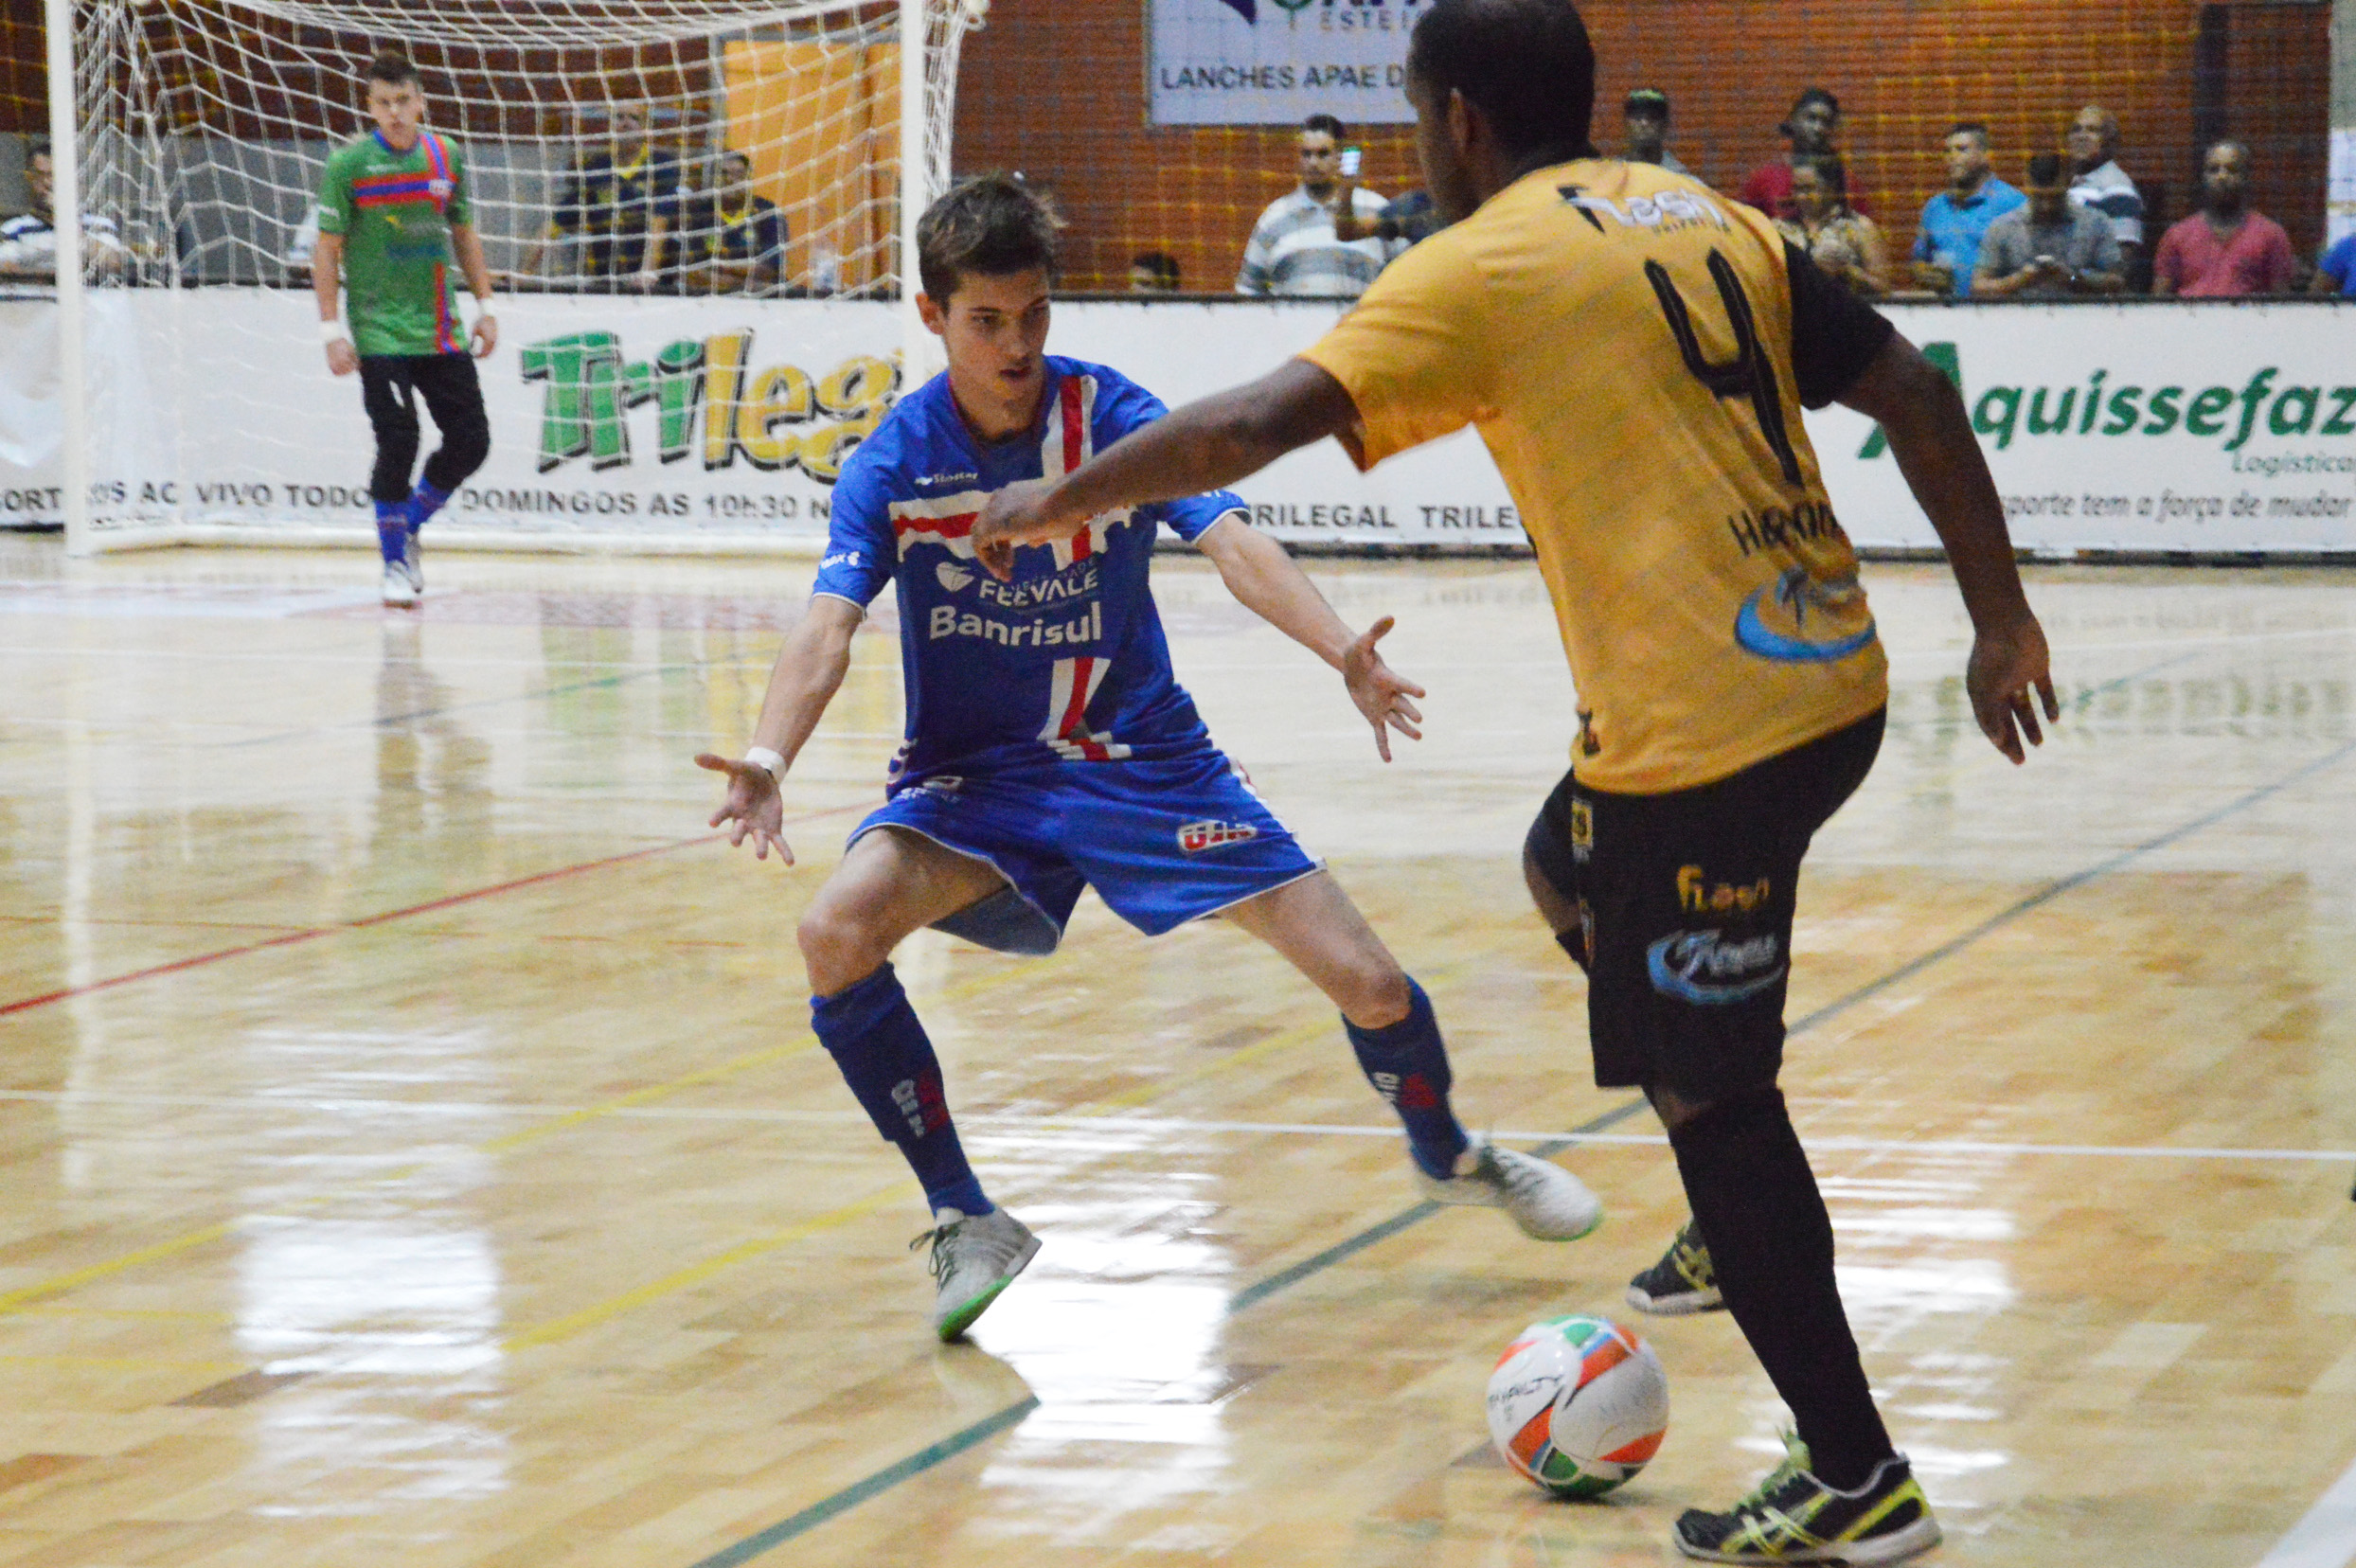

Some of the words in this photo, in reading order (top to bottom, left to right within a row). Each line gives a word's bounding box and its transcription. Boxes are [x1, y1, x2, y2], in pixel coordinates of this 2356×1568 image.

[1160, 65, 1295, 89] LANCHES
[1302, 64, 1377, 88] APAE
[1385, 62, 1404, 88] D
[1644, 245, 1805, 488] 4
[520, 327, 904, 484] Trileg
[195, 482, 274, 506] VIVO
[284, 484, 372, 508] TODO
[460, 487, 636, 516] DOMINGOS
[650, 491, 689, 516] AS
[1250, 504, 1399, 528] RILEGAL
[1419, 505, 1516, 529] TRILE
[929, 600, 1101, 647] Banrisul
